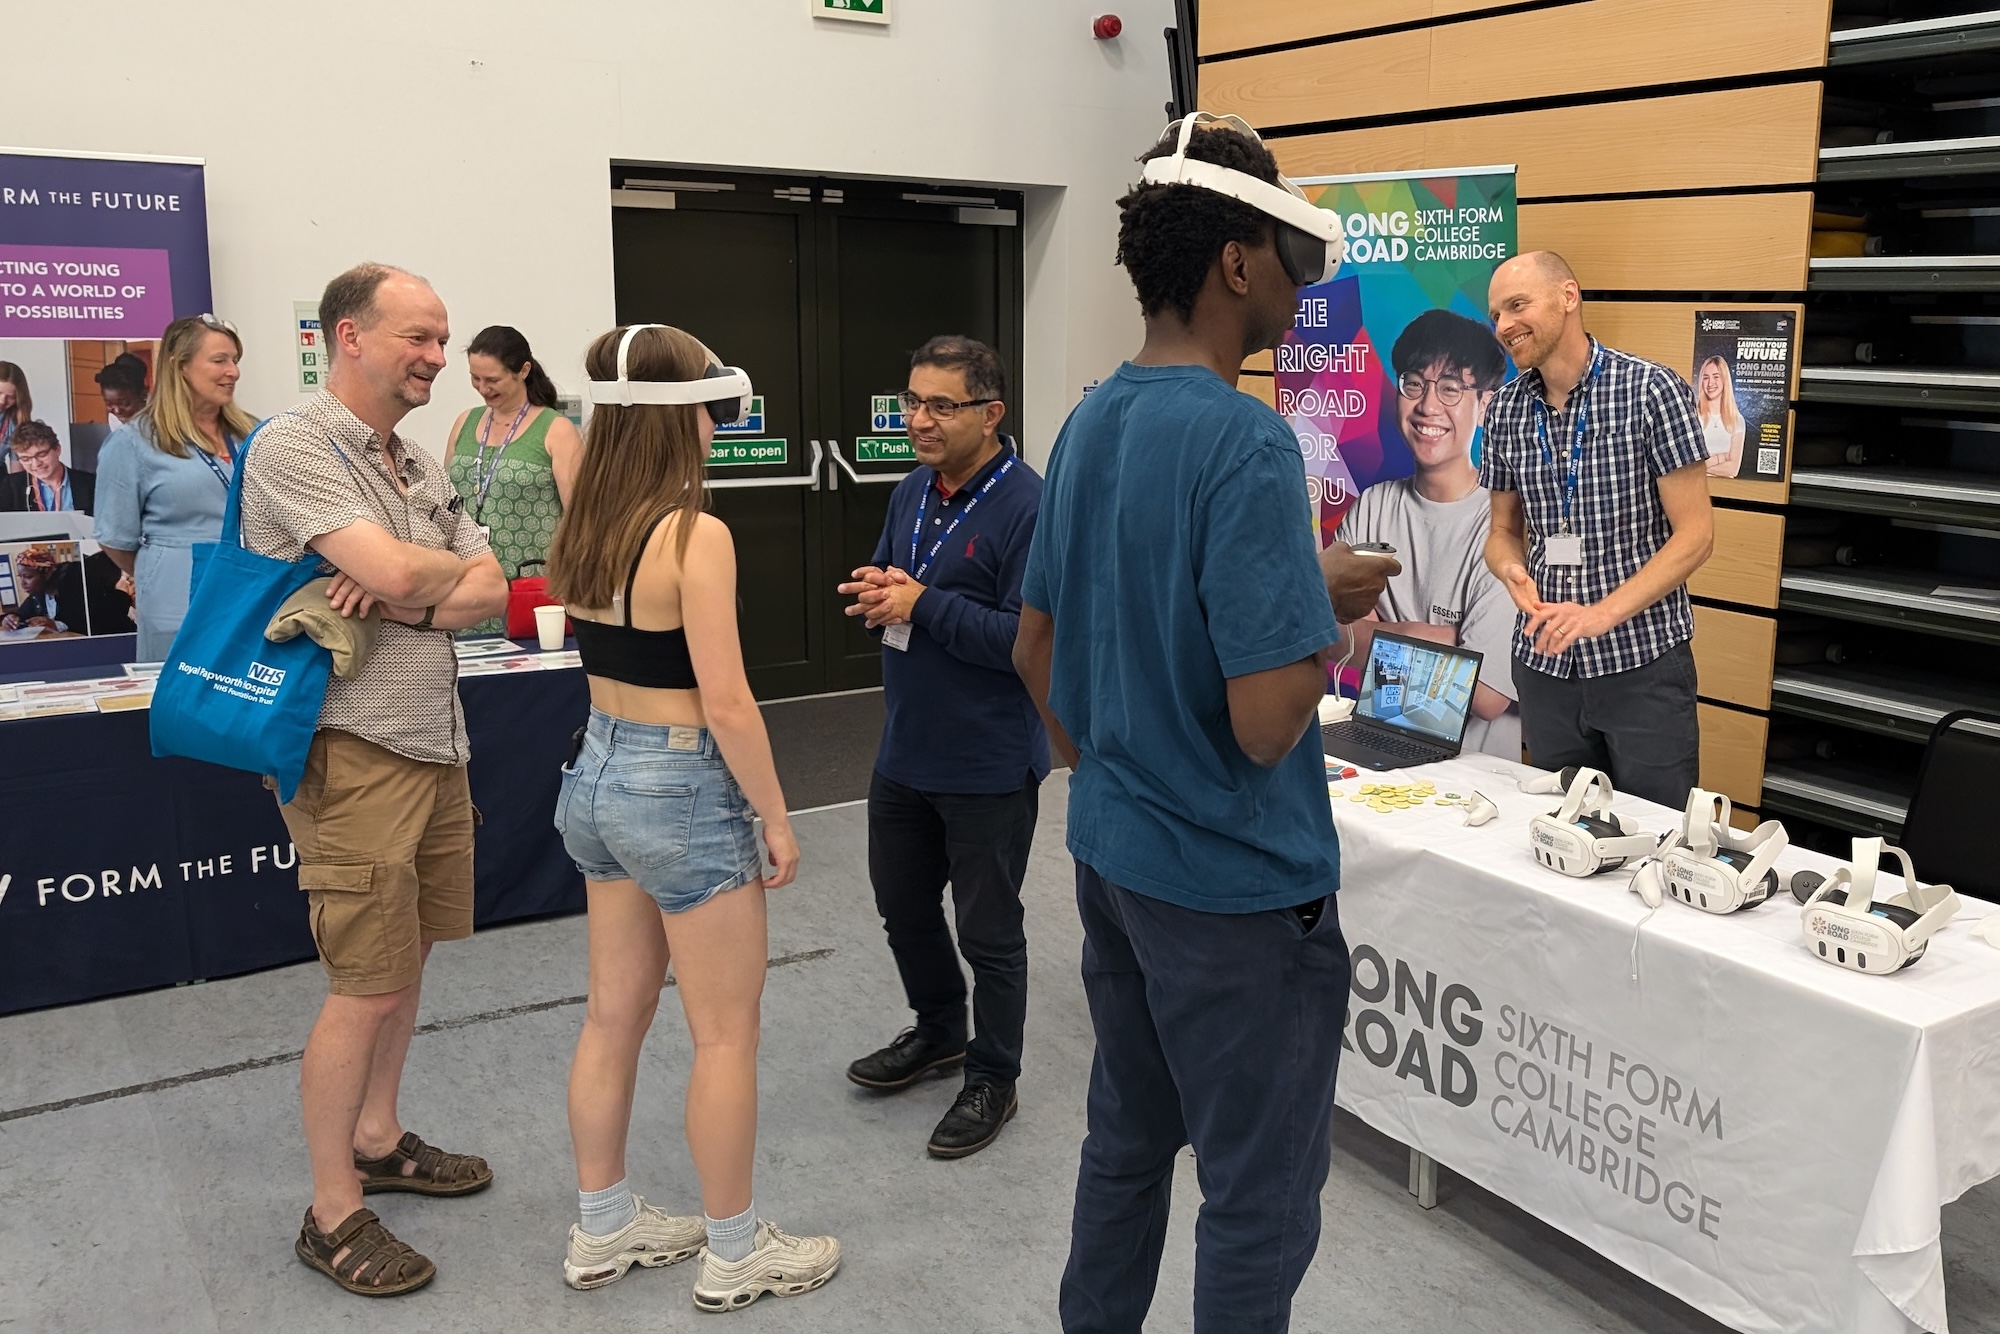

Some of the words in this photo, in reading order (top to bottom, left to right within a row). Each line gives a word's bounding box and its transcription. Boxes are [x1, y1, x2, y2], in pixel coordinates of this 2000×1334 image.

[48, 191, 82, 206] THE
[91, 191, 181, 212] FUTURE
[1338, 210, 1410, 238] ONG
[1414, 208, 1454, 226] SIXTH
[1458, 206, 1504, 224] FORM
[1414, 225, 1480, 244] COLLEGE
[1414, 243, 1506, 262] CAMBRIDGE
[52, 262, 121, 277] YOUNG
[0, 283, 27, 297] TO
[32, 284, 46, 297] A
[49, 284, 117, 298] WORLD
[121, 285, 146, 298] OF
[4, 305, 125, 319] POSSIBILITIES
[1766, 341, 1787, 349] YOUR
[1277, 343, 1369, 373] RIGHT
[1736, 348, 1787, 361] FUTURE
[1736, 362, 1760, 371] LONG
[1760, 363, 1786, 372] ROAD
[1279, 388, 1367, 418] ROAD
[881, 442, 909, 454] Push
[1298, 432, 1340, 462] OR
[1576, 431, 1584, 449] STAFF
[733, 446, 747, 457] to
[750, 447, 782, 459] open
[1570, 458, 1579, 476] STAFF
[982, 477, 997, 494] STAFF
[963, 497, 978, 515] STAFF
[946, 518, 960, 535] STAFF
[929, 540, 942, 558] STAFF
[915, 562, 928, 580] STAFF
[1432, 604, 1462, 619] ESSENT
[178, 661, 201, 676] Royal
[200, 667, 243, 688] Papworth
[249, 663, 285, 684] NHS
[213, 683, 228, 693] NHS
[258, 694, 274, 706] Trust
[1385, 686, 1401, 696] NHS
[37, 863, 163, 907] FORM
[179, 854, 233, 882] THE
[251, 842, 297, 874] FU
[1677, 866, 1693, 877] LONG
[1677, 872, 1693, 882] ROAD
[1827, 923, 1850, 935] LONG
[1827, 929, 1849, 941] ROAD
[1349, 943, 1484, 1047] ONG
[1496, 1003, 1593, 1080] SIXTH
[1606, 1050, 1724, 1141] FORM
[1494, 1050, 1657, 1160] COLLEGE
[1490, 1094, 1722, 1241] CAMBRIDGE
